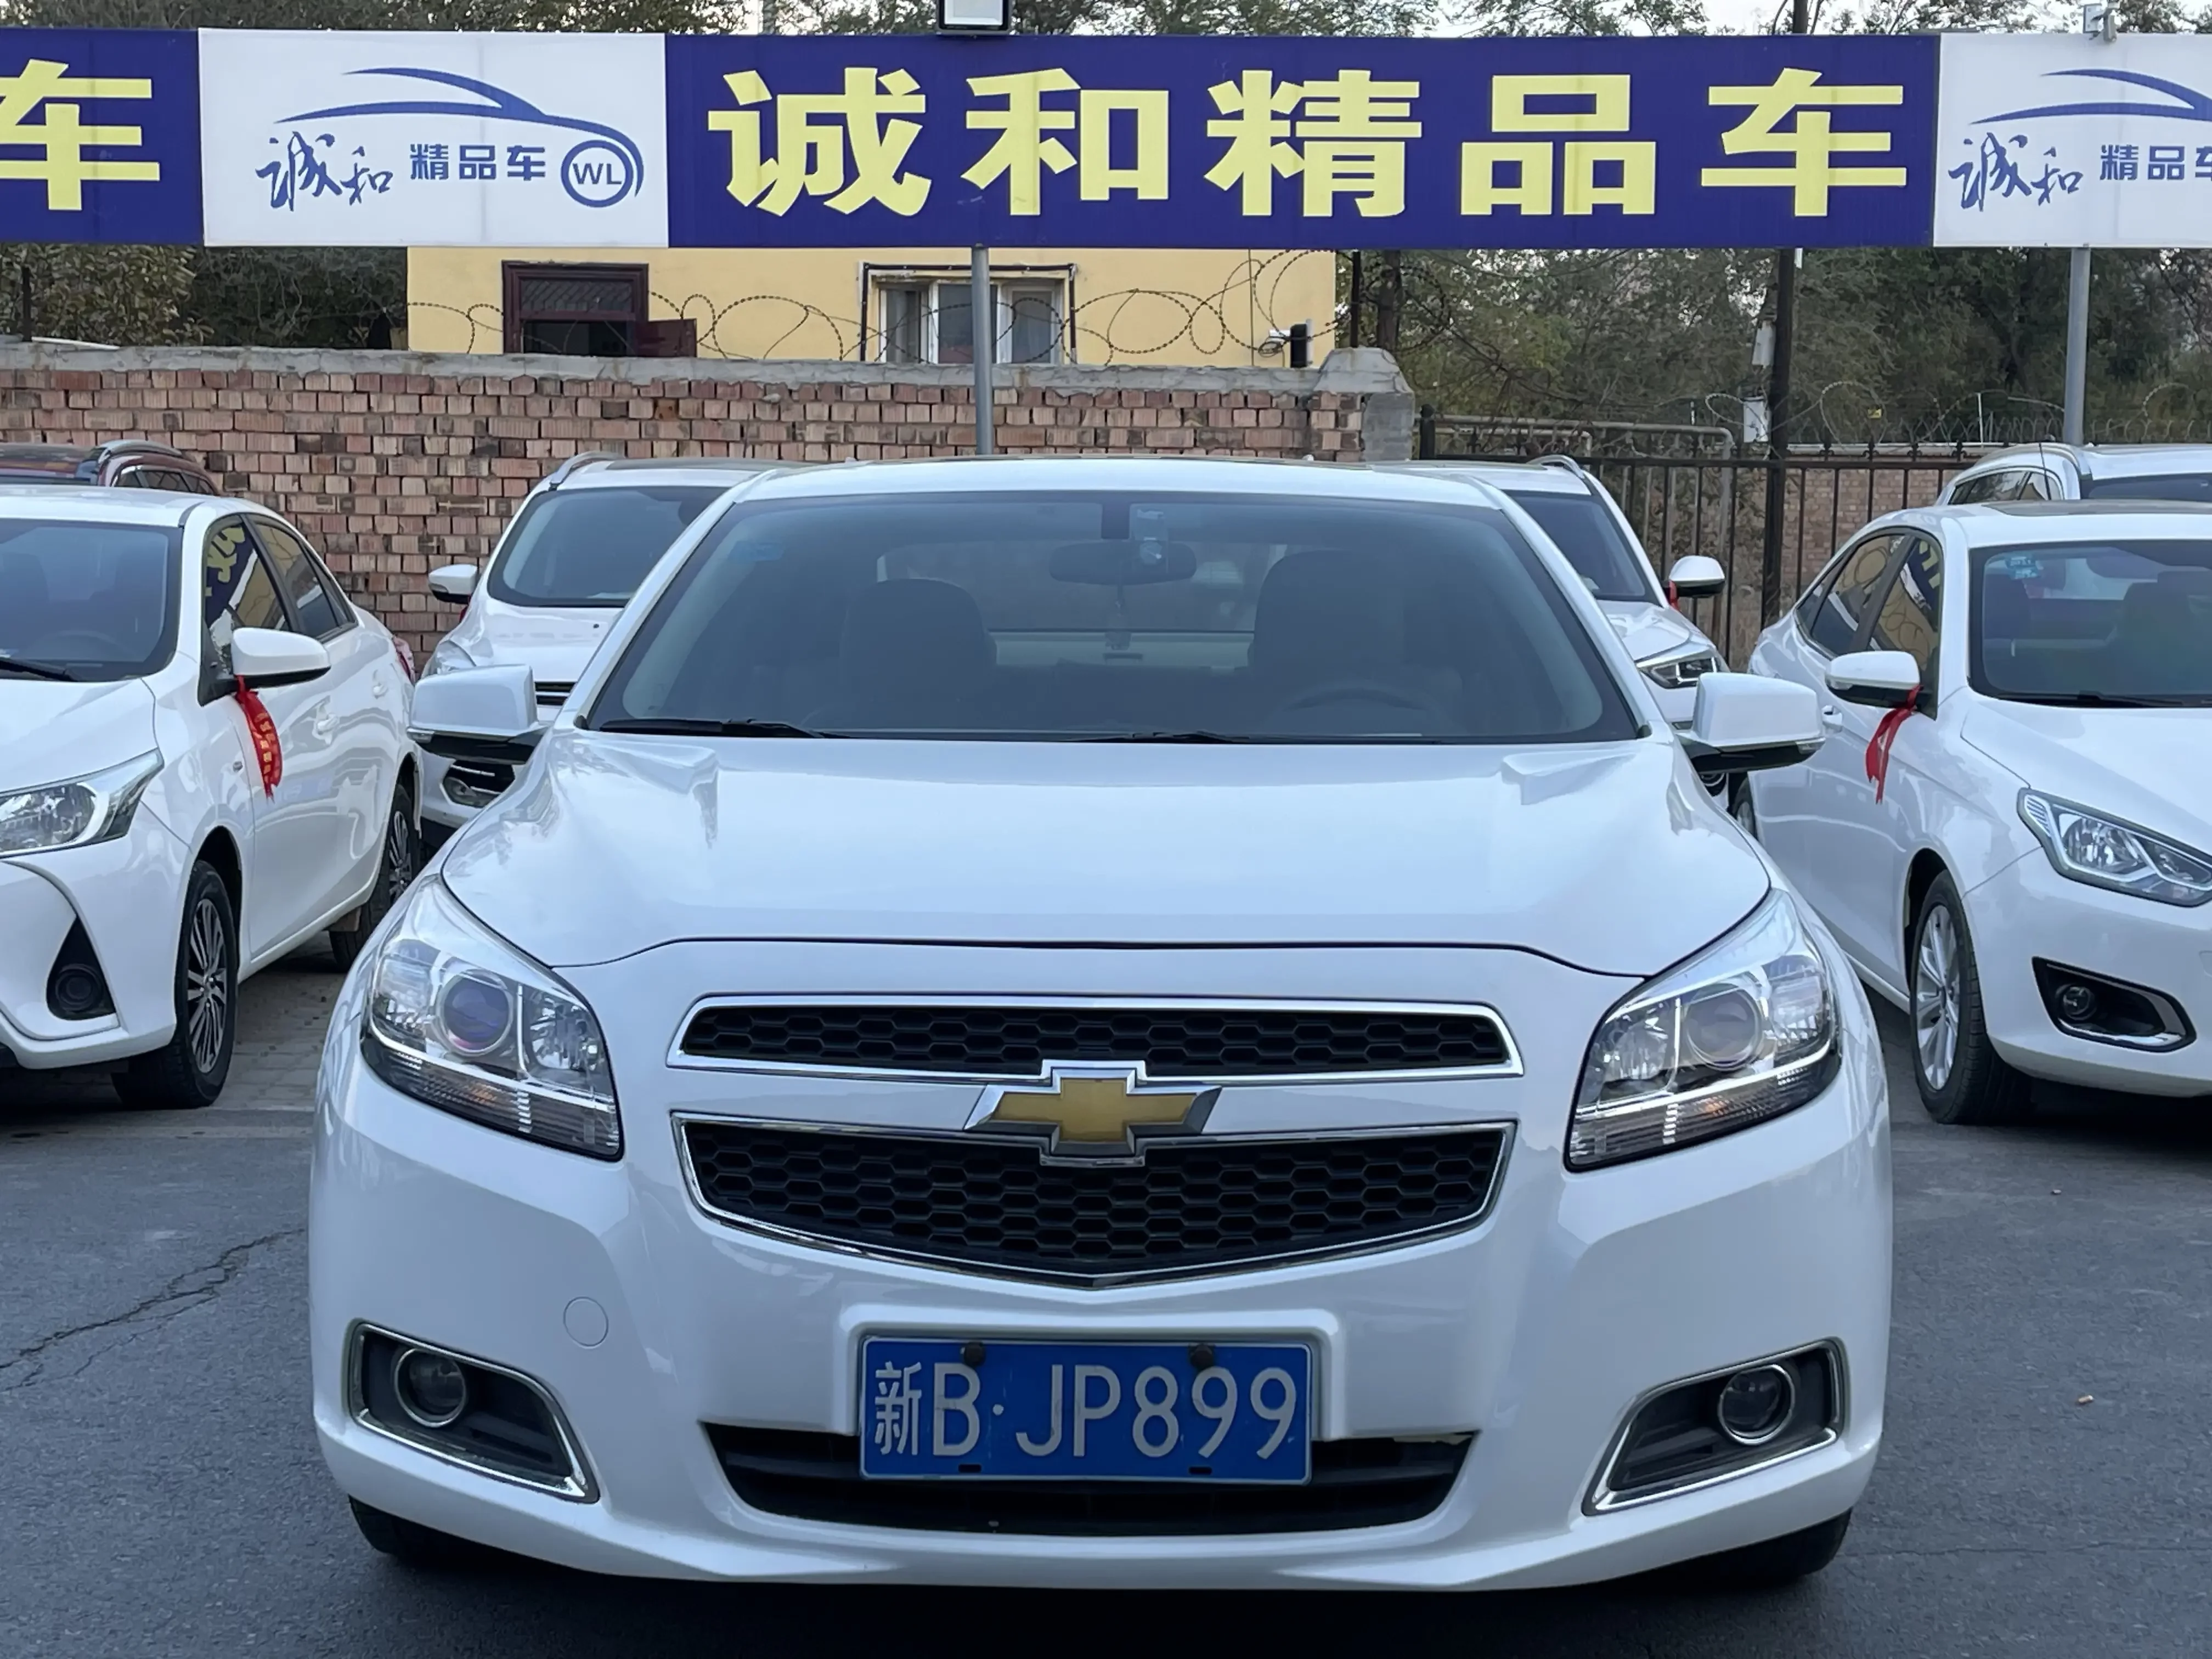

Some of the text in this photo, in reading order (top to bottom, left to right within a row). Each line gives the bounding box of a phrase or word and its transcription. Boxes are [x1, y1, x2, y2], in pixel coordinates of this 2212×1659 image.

[708, 67, 1907, 218] 诚和精品车
[410, 144, 547, 182] 精品车
[572, 162, 623, 186] WL
